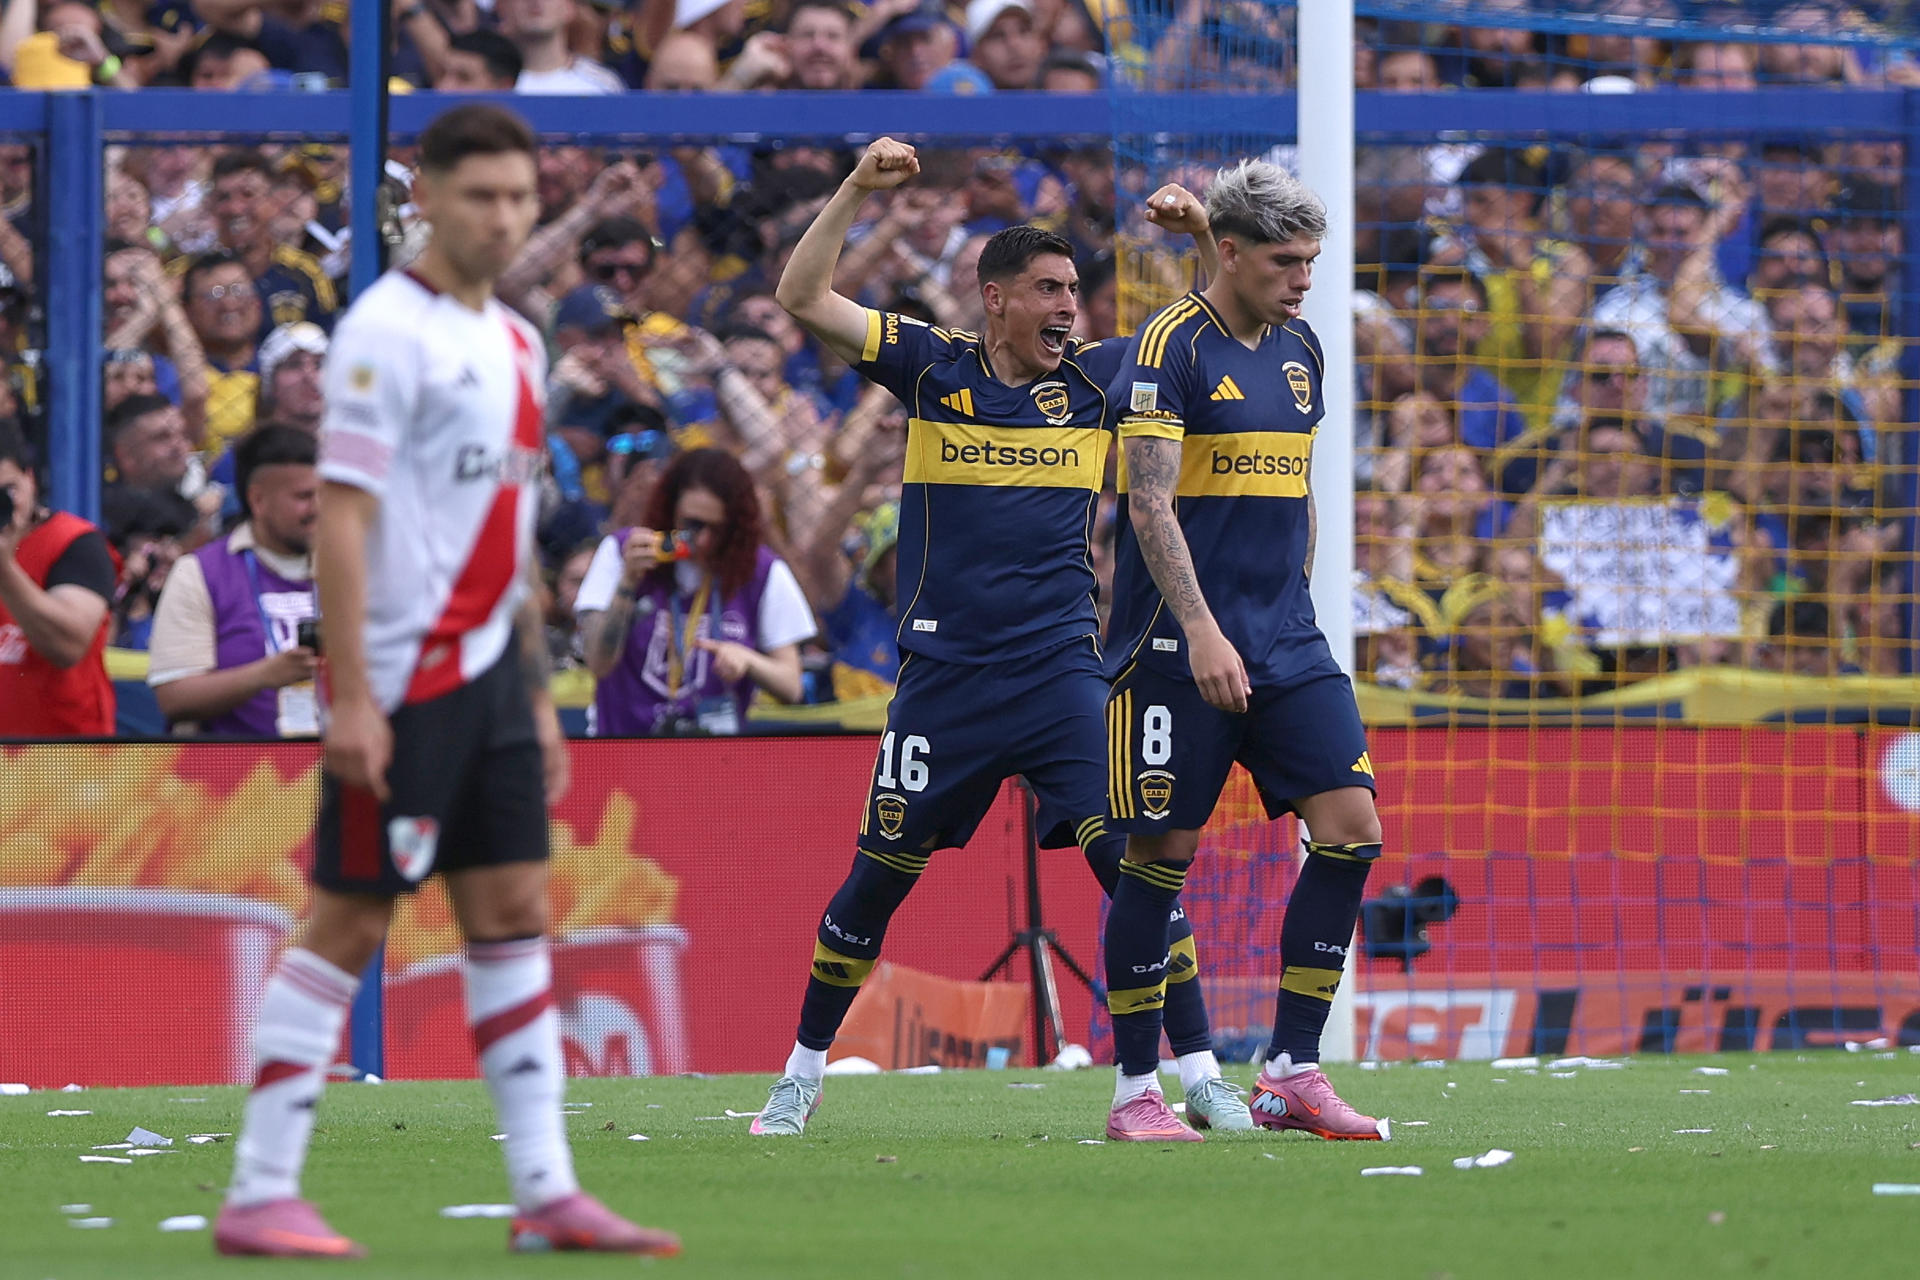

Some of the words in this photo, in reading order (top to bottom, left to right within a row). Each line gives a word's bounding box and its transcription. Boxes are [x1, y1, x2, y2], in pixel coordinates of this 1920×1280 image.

[941, 438, 1079, 467] betsson
[877, 730, 931, 792] 16
[1141, 705, 1172, 765] 8
